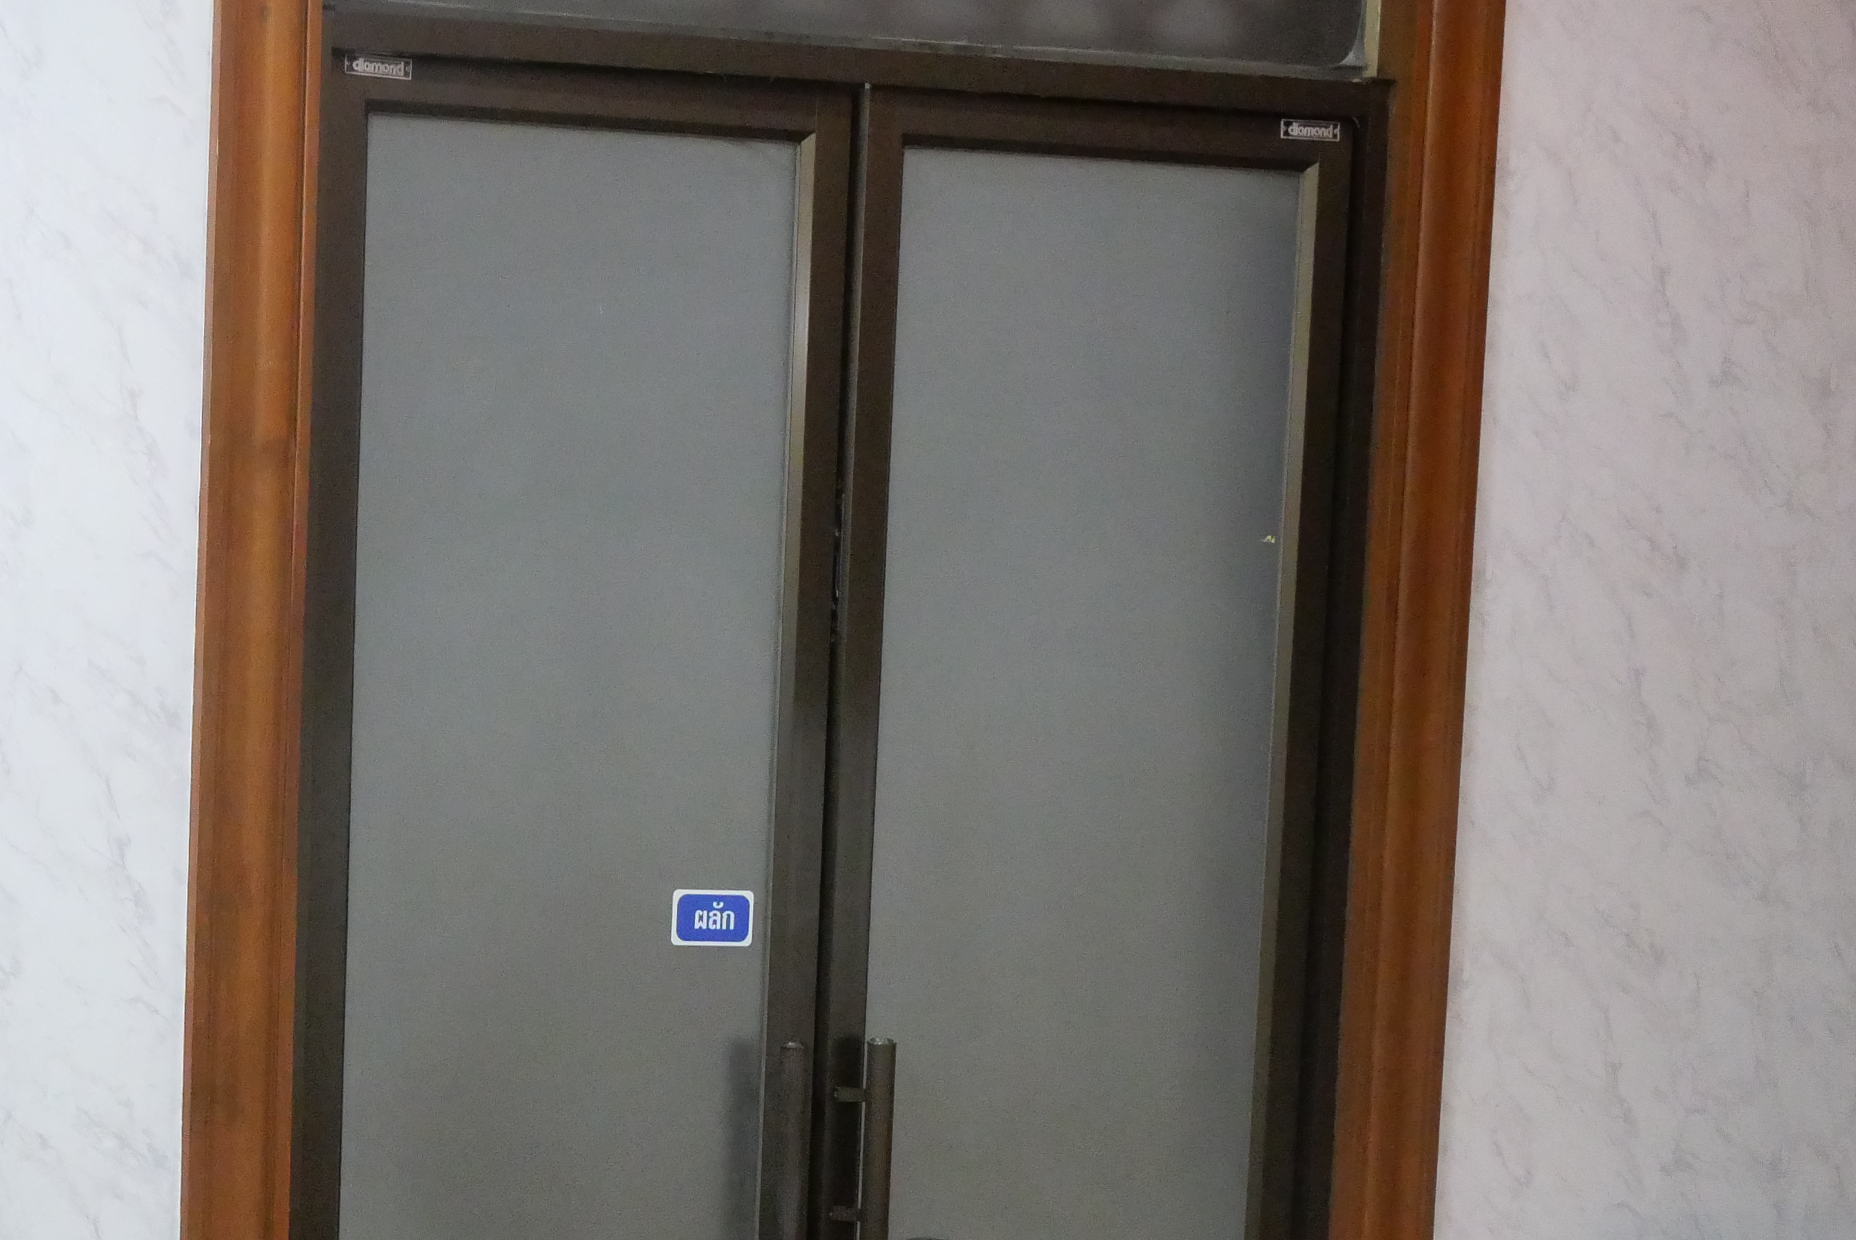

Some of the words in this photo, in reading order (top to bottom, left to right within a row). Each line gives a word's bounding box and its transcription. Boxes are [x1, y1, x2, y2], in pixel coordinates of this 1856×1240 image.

[352, 57, 405, 76] diamond
[1287, 122, 1333, 139] diamond
[693, 901, 735, 931] ผลัก
